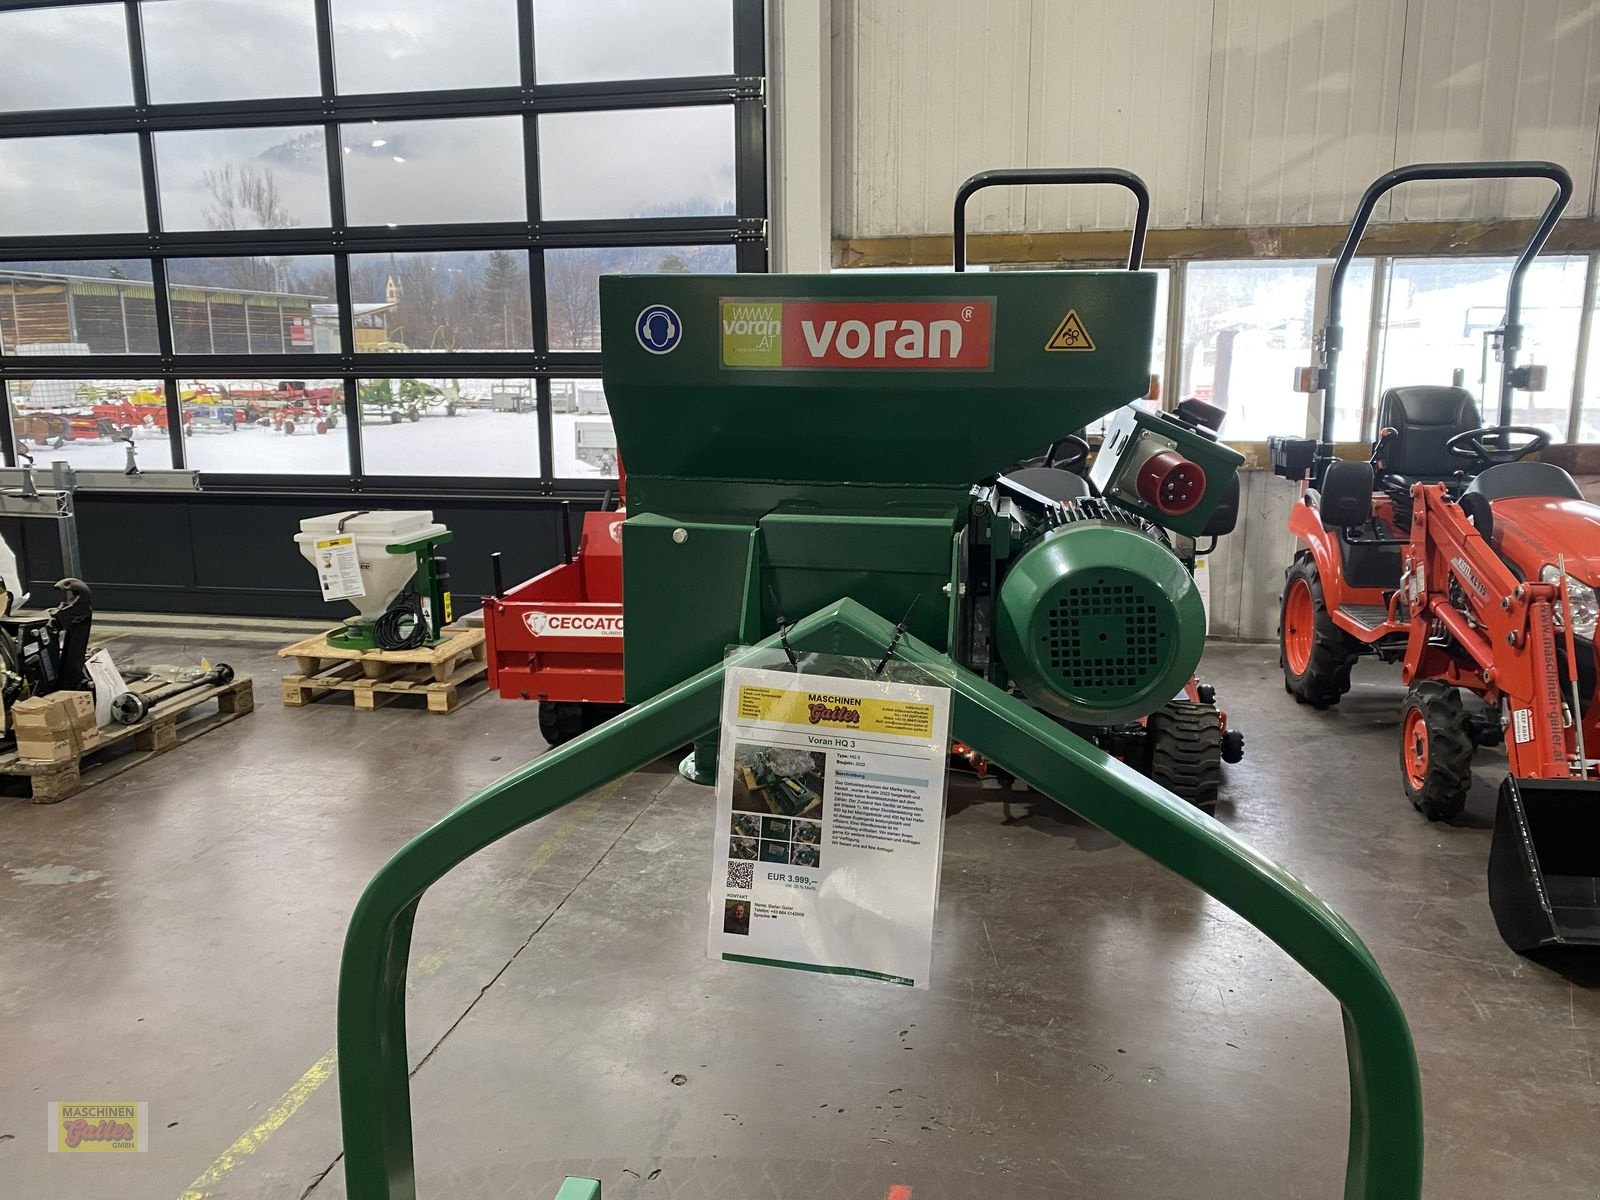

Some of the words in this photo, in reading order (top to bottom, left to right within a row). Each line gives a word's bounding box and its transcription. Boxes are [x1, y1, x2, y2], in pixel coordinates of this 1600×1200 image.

[723, 320, 780, 336] voran
[801, 318, 963, 358] voran
[808, 694, 862, 706] MASCHINEN
[808, 704, 860, 724] Gailer
[808, 736, 833, 745] Voran
[834, 738, 849, 748] HQ
[767, 872, 785, 881] EUR
